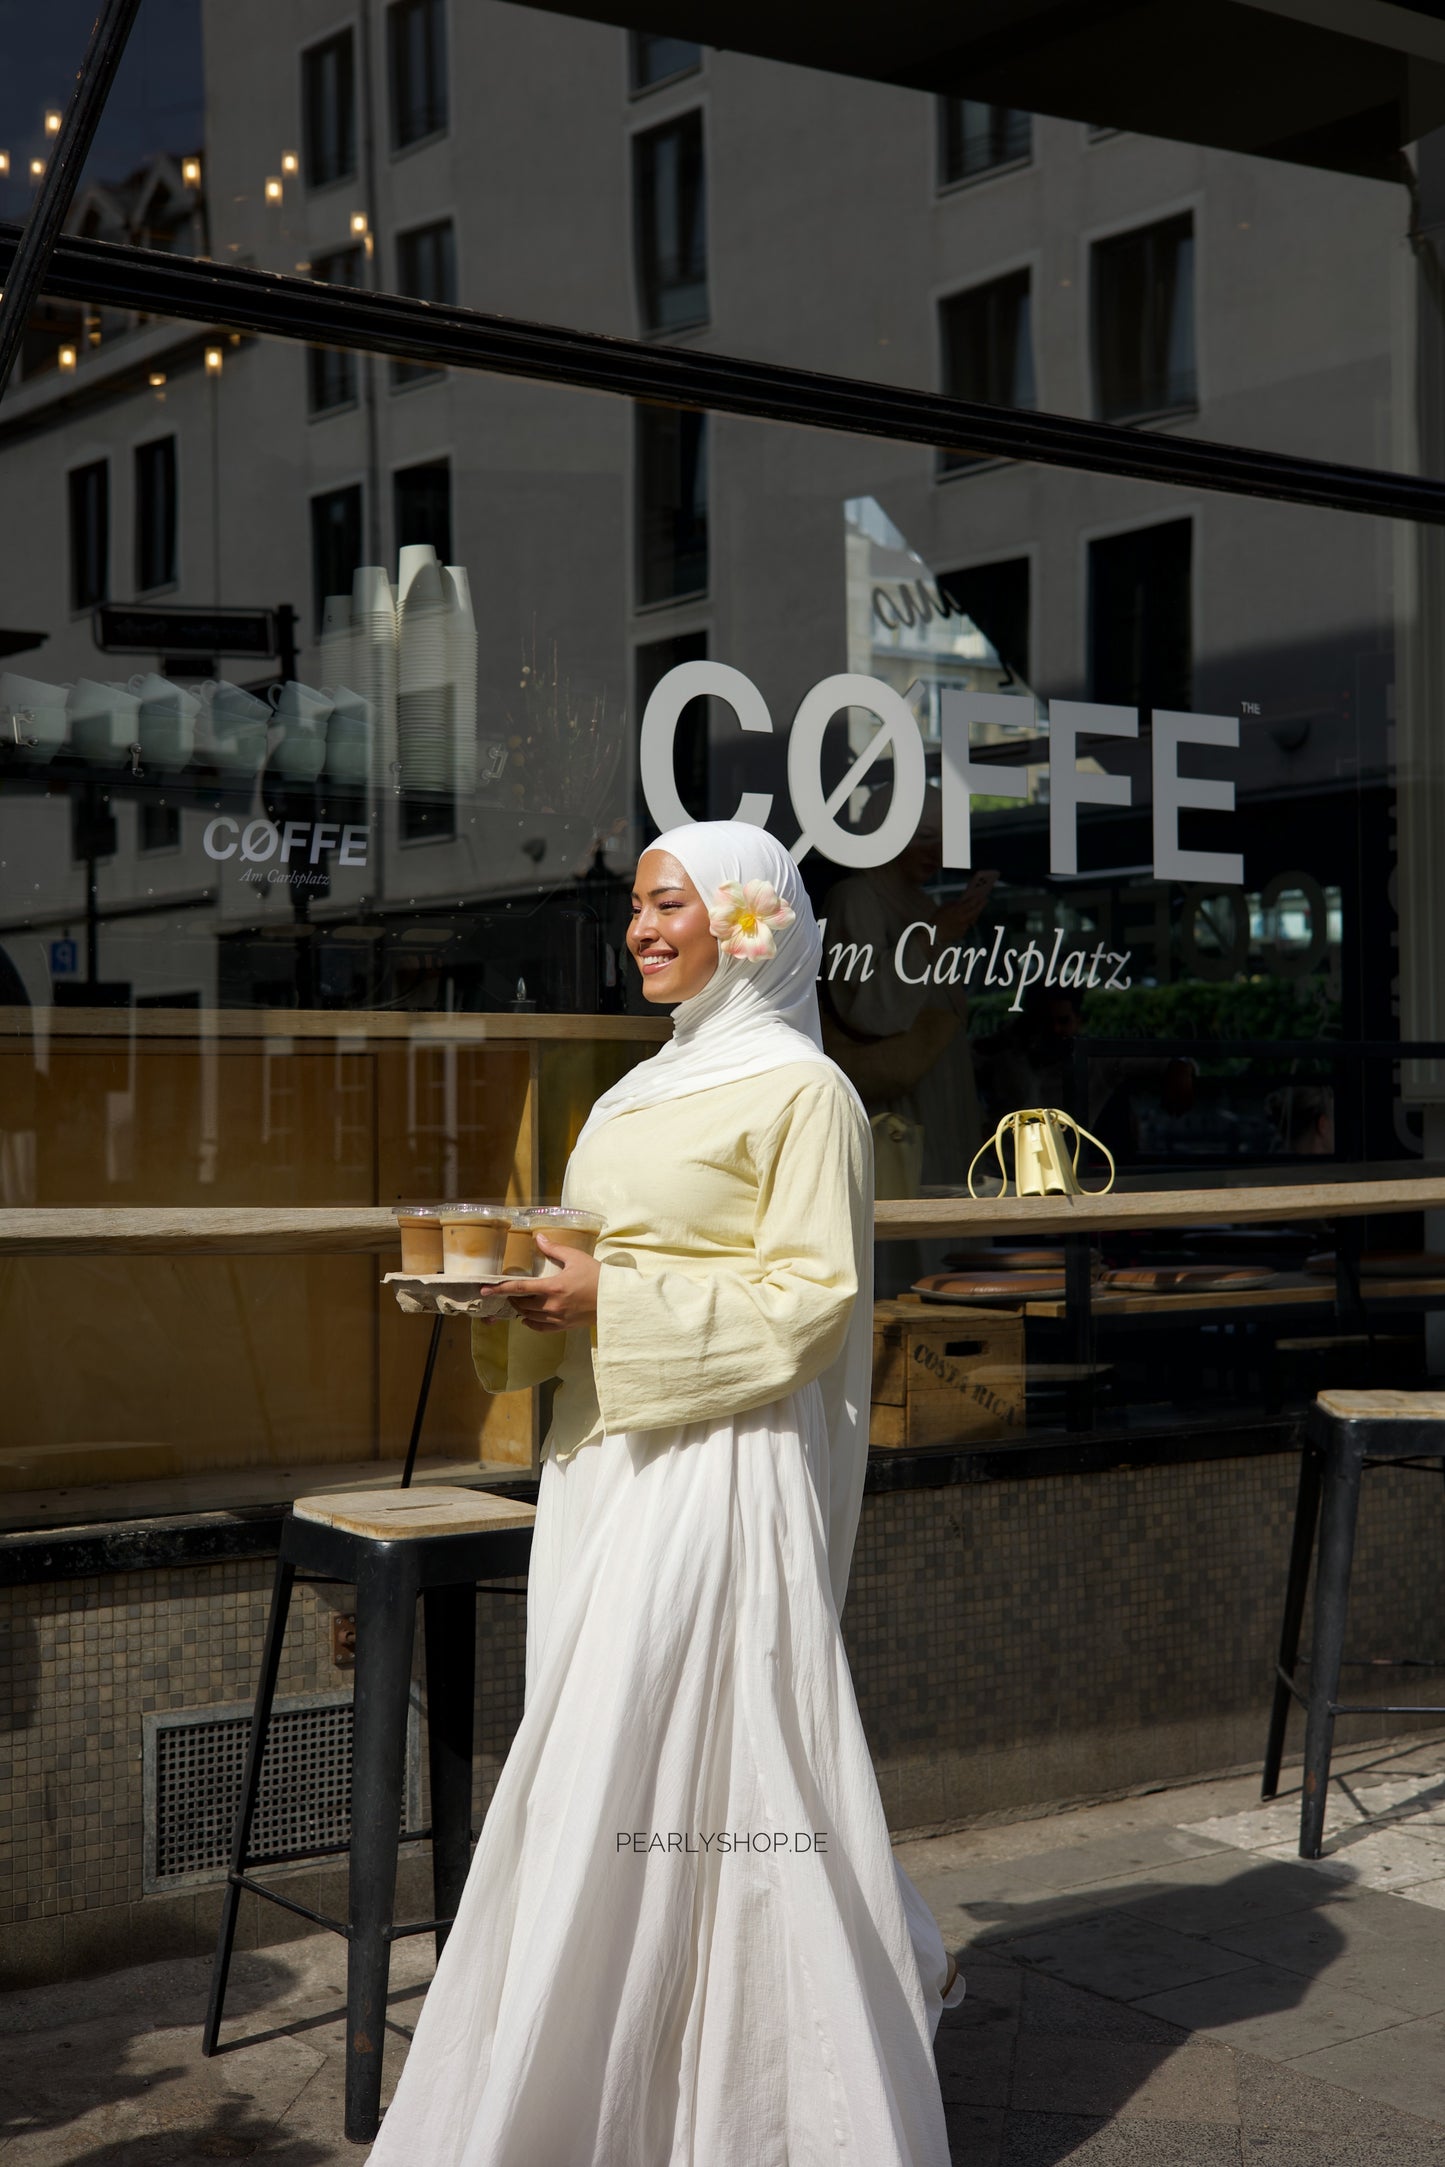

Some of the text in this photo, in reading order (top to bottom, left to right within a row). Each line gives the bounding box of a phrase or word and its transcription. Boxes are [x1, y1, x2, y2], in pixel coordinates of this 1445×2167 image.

[240, 868, 331, 888] Am Carlsplatz
[894, 922, 1132, 1012] Carlsplatz
